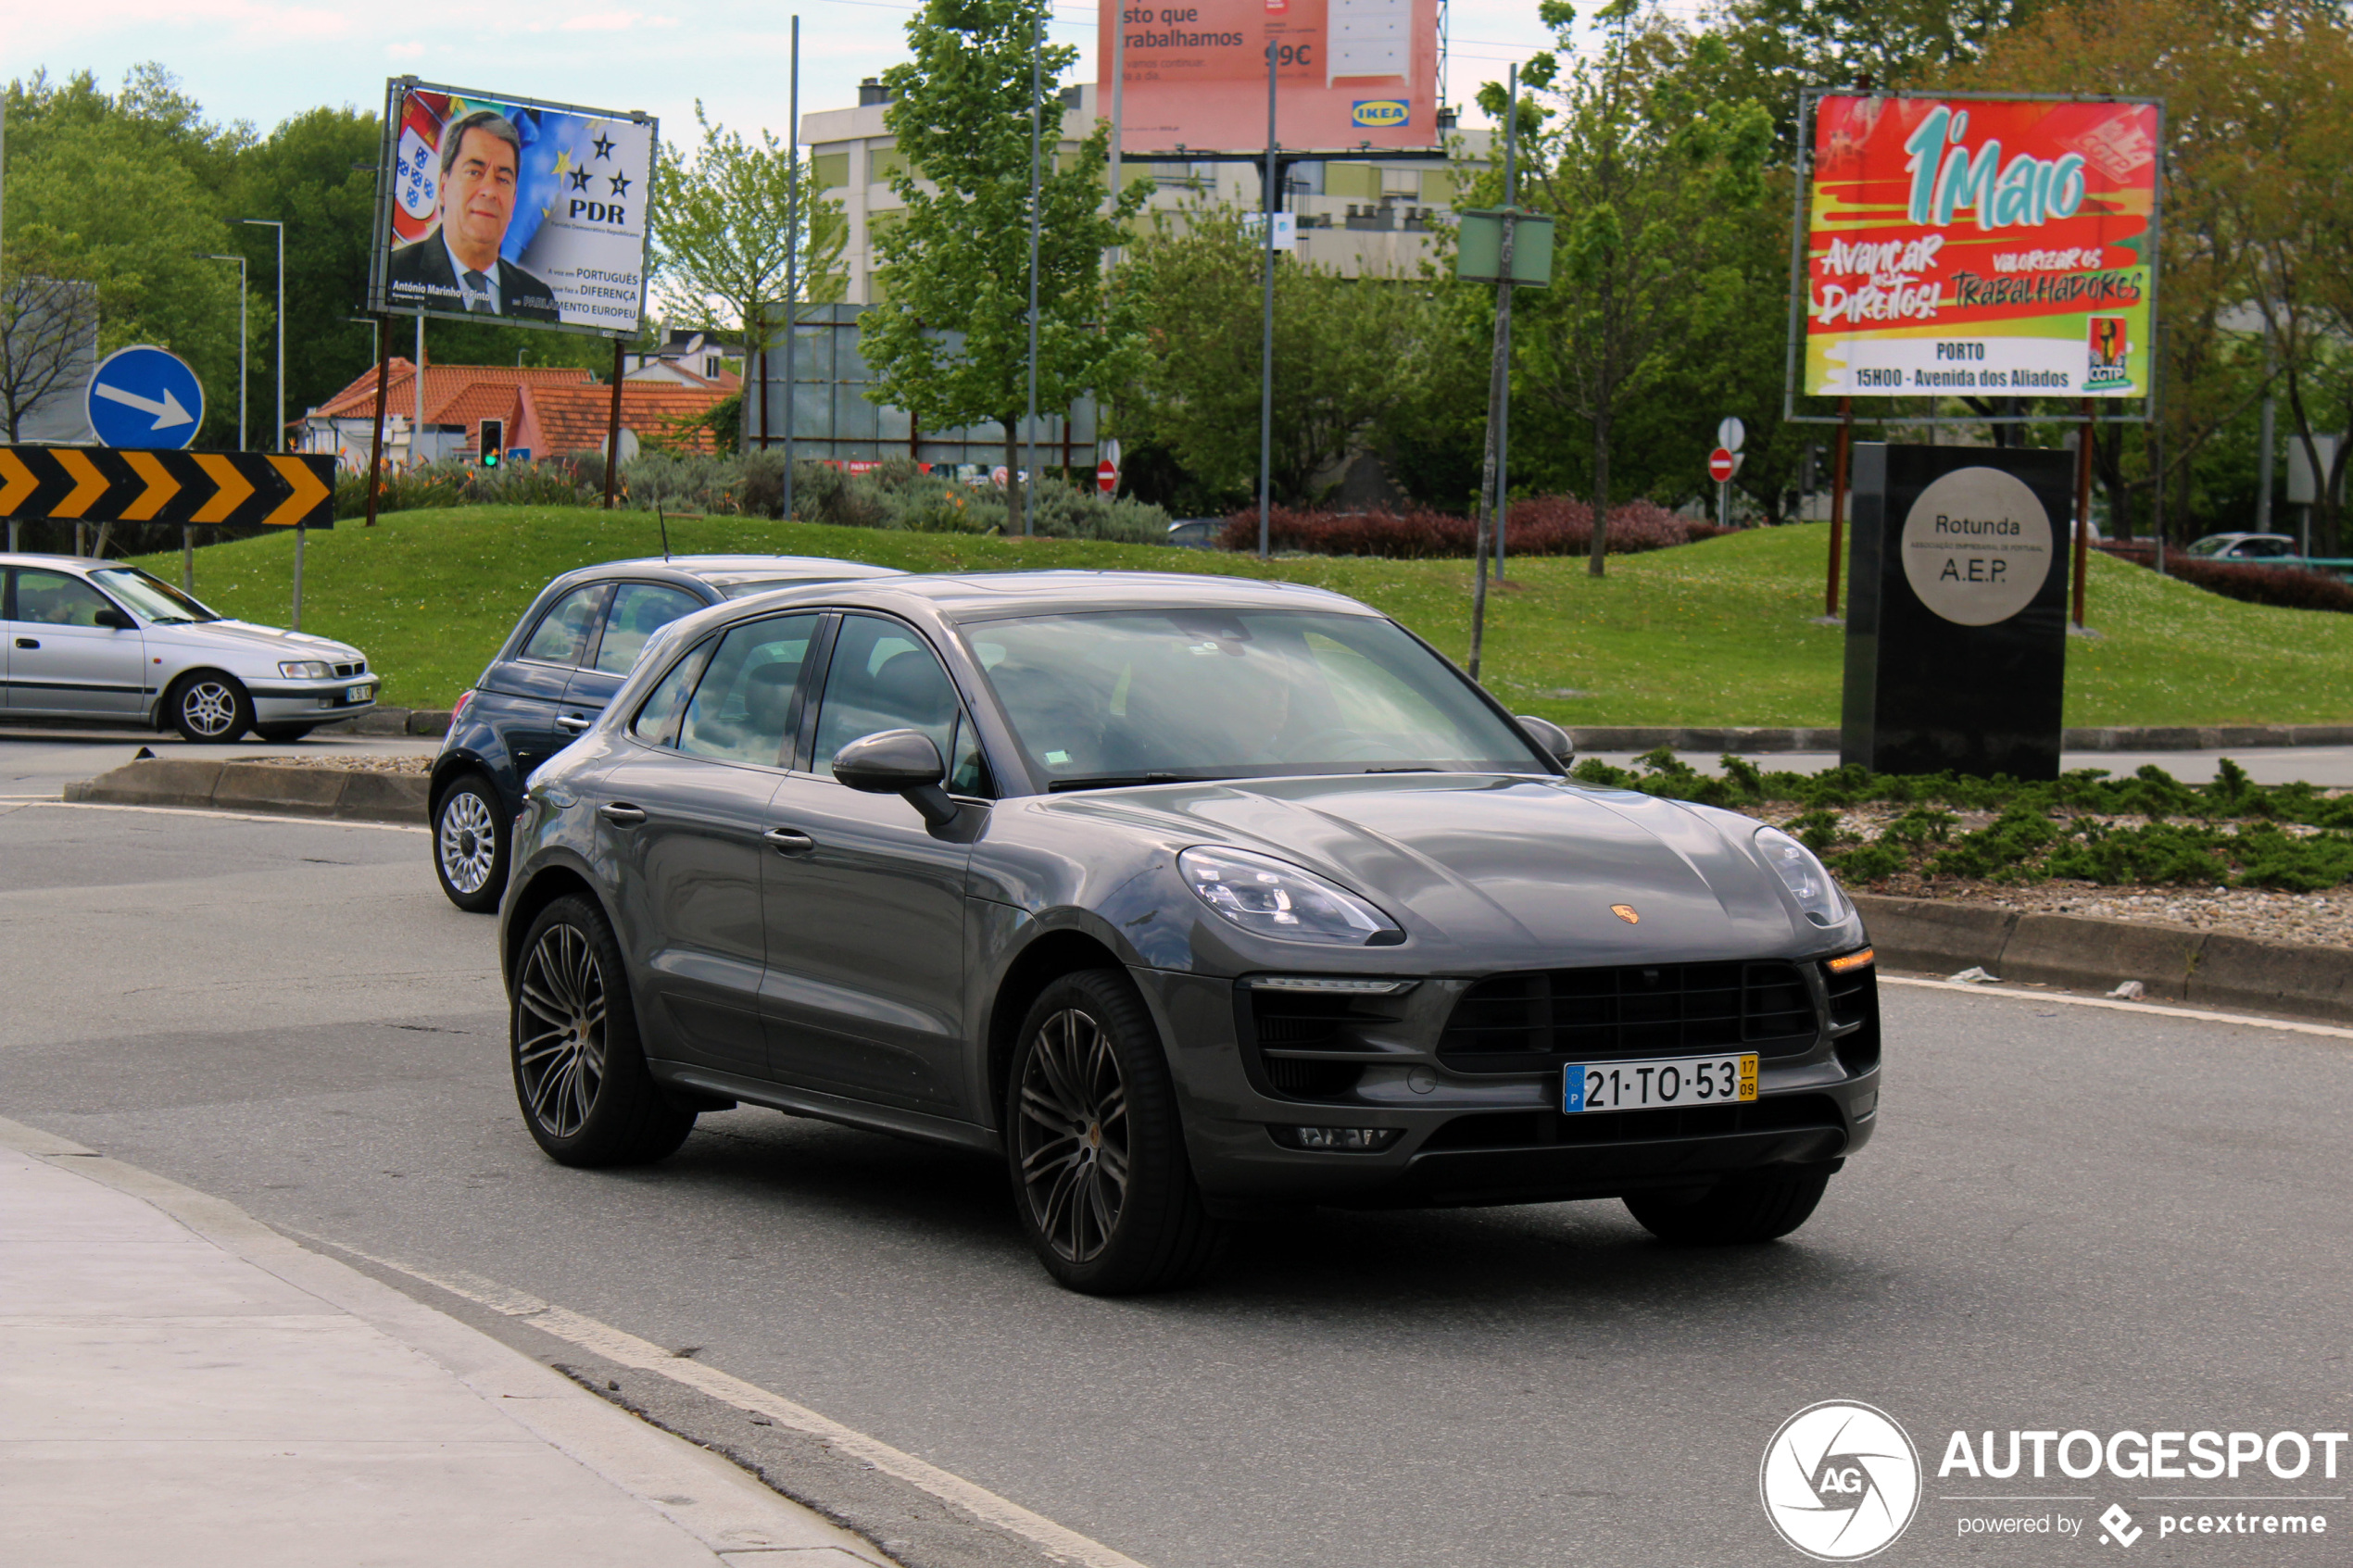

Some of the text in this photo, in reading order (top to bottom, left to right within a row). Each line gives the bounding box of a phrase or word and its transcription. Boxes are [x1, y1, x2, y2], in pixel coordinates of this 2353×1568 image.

[1161, 8, 1198, 26] que
[1123, 30, 1242, 48] rabalhamos
[1357, 107, 1403, 119] IKEA
[599, 142, 607, 154] J
[616, 179, 623, 192] S
[570, 198, 625, 225] PDR
[576, 268, 638, 285] PORTUGUÊS
[392, 279, 426, 294] António
[427, 283, 461, 298] Marinho
[469, 289, 490, 302] Pinto
[580, 284, 636, 303] DIFERENÇA
[523, 295, 590, 313] PARLAMENTO
[592, 305, 636, 319] EUROPEU
[1936, 343, 1985, 360] PORTO
[1856, 369, 1903, 387] 15H00
[1915, 370, 1976, 387] Avenida
[1980, 370, 2007, 387] dos
[2011, 370, 2070, 388] Aliados
[2089, 366, 2125, 382] CGTP
[1934, 514, 2021, 535] Rotunda
[1939, 558, 2007, 583] A.E.P.
[1742, 1060, 1755, 1073] 17
[1740, 1083, 1755, 1096] 09
[1570, 1093, 1579, 1105] P
